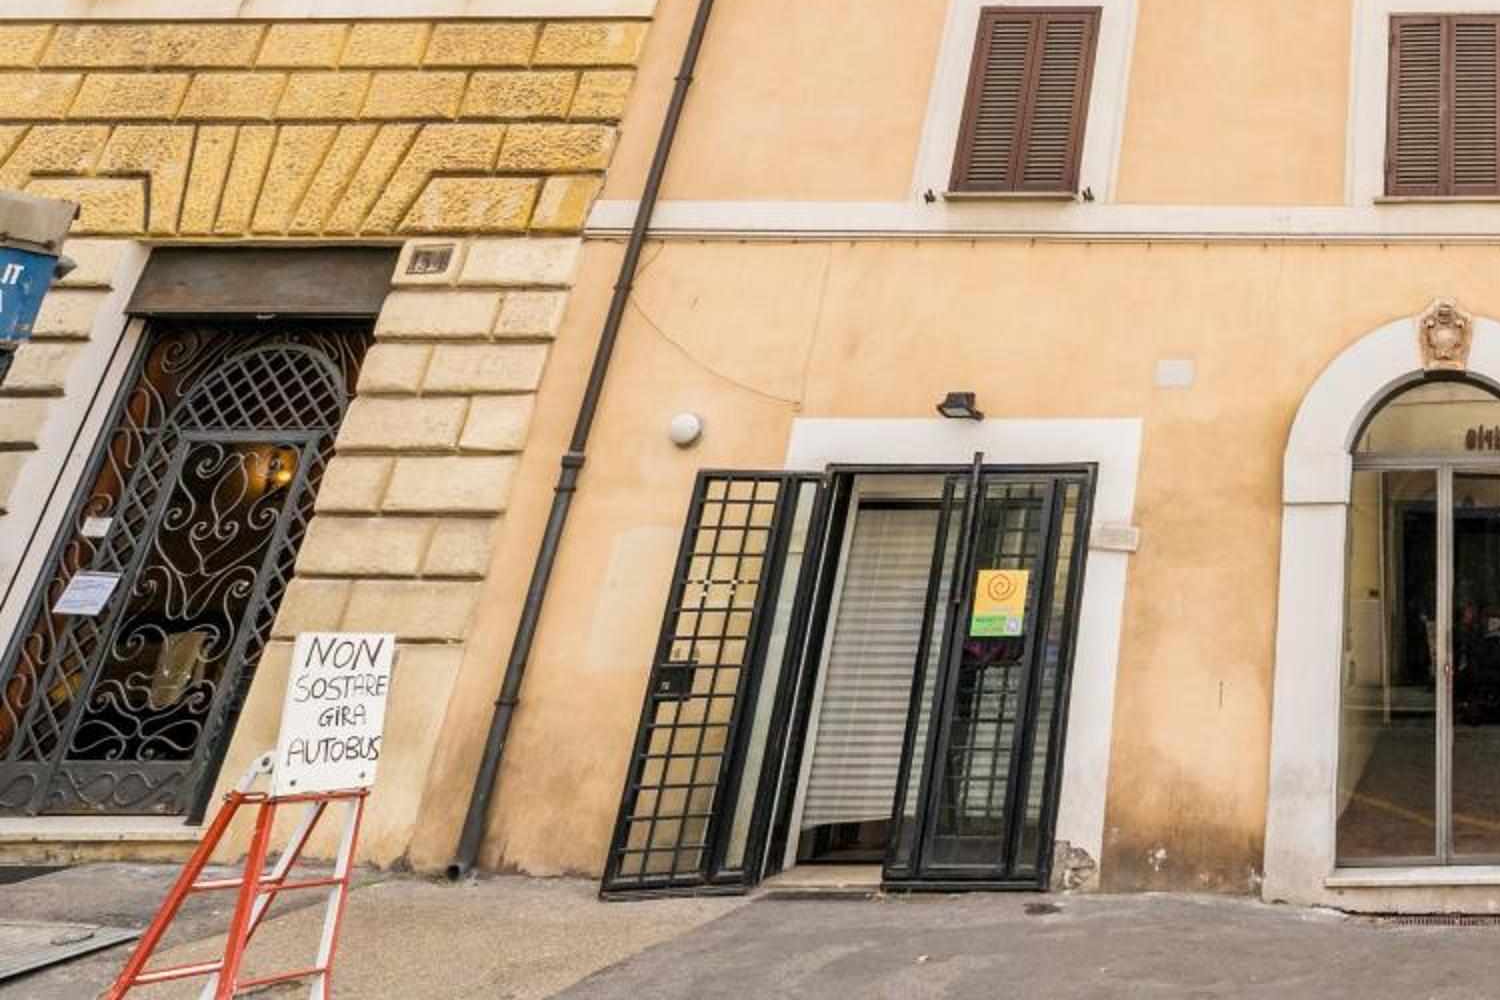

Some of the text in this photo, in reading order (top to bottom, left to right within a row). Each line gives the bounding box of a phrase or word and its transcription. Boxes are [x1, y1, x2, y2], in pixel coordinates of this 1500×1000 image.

[305, 637, 384, 670] NON
[294, 674, 387, 702] SOSTARE
[287, 735, 381, 766] AUTOBUS
